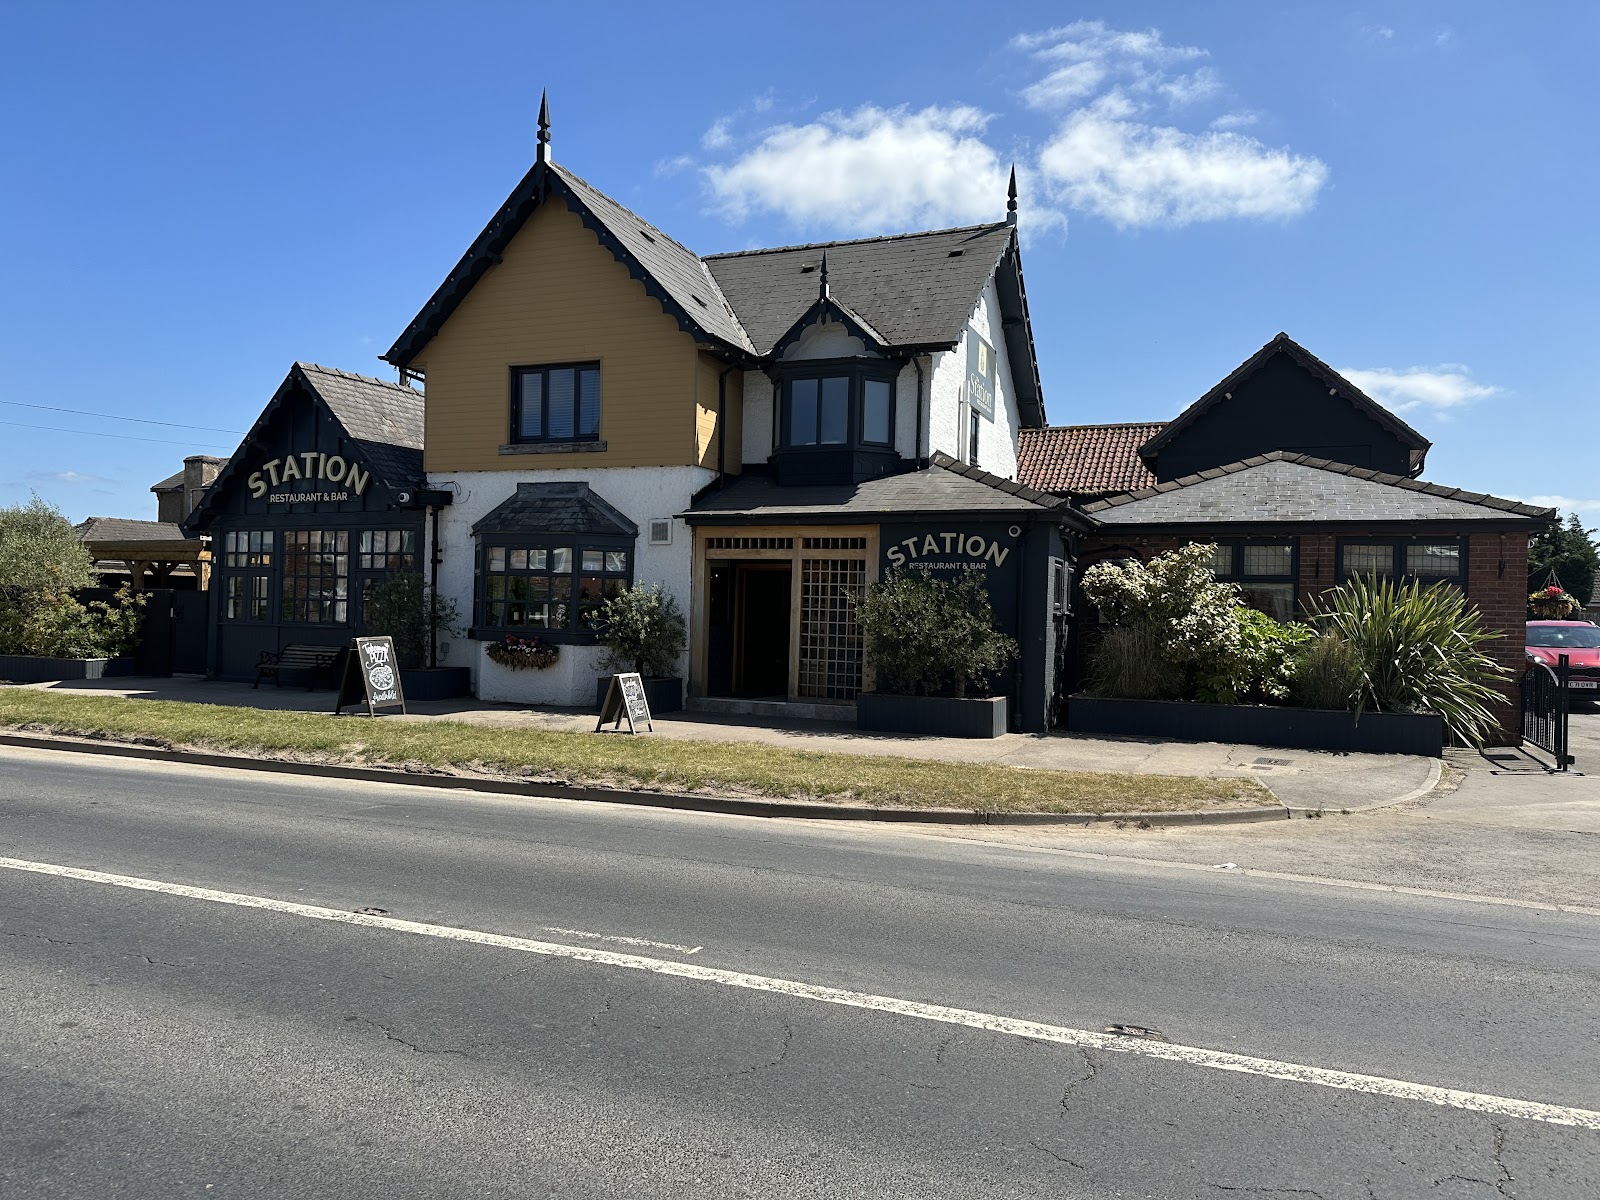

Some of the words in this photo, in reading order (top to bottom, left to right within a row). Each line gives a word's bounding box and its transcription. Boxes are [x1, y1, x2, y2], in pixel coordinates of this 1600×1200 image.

[248, 452, 370, 498] STATION
[270, 493, 322, 502] RESTAURANT
[323, 493, 330, 501] &
[330, 492, 348, 501] BAR
[886, 532, 1010, 568] STATION
[909, 562, 961, 570] RESTAURANT
[962, 562, 969, 570] &
[970, 562, 987, 570] BAR
[369, 652, 389, 663] PIZZA
